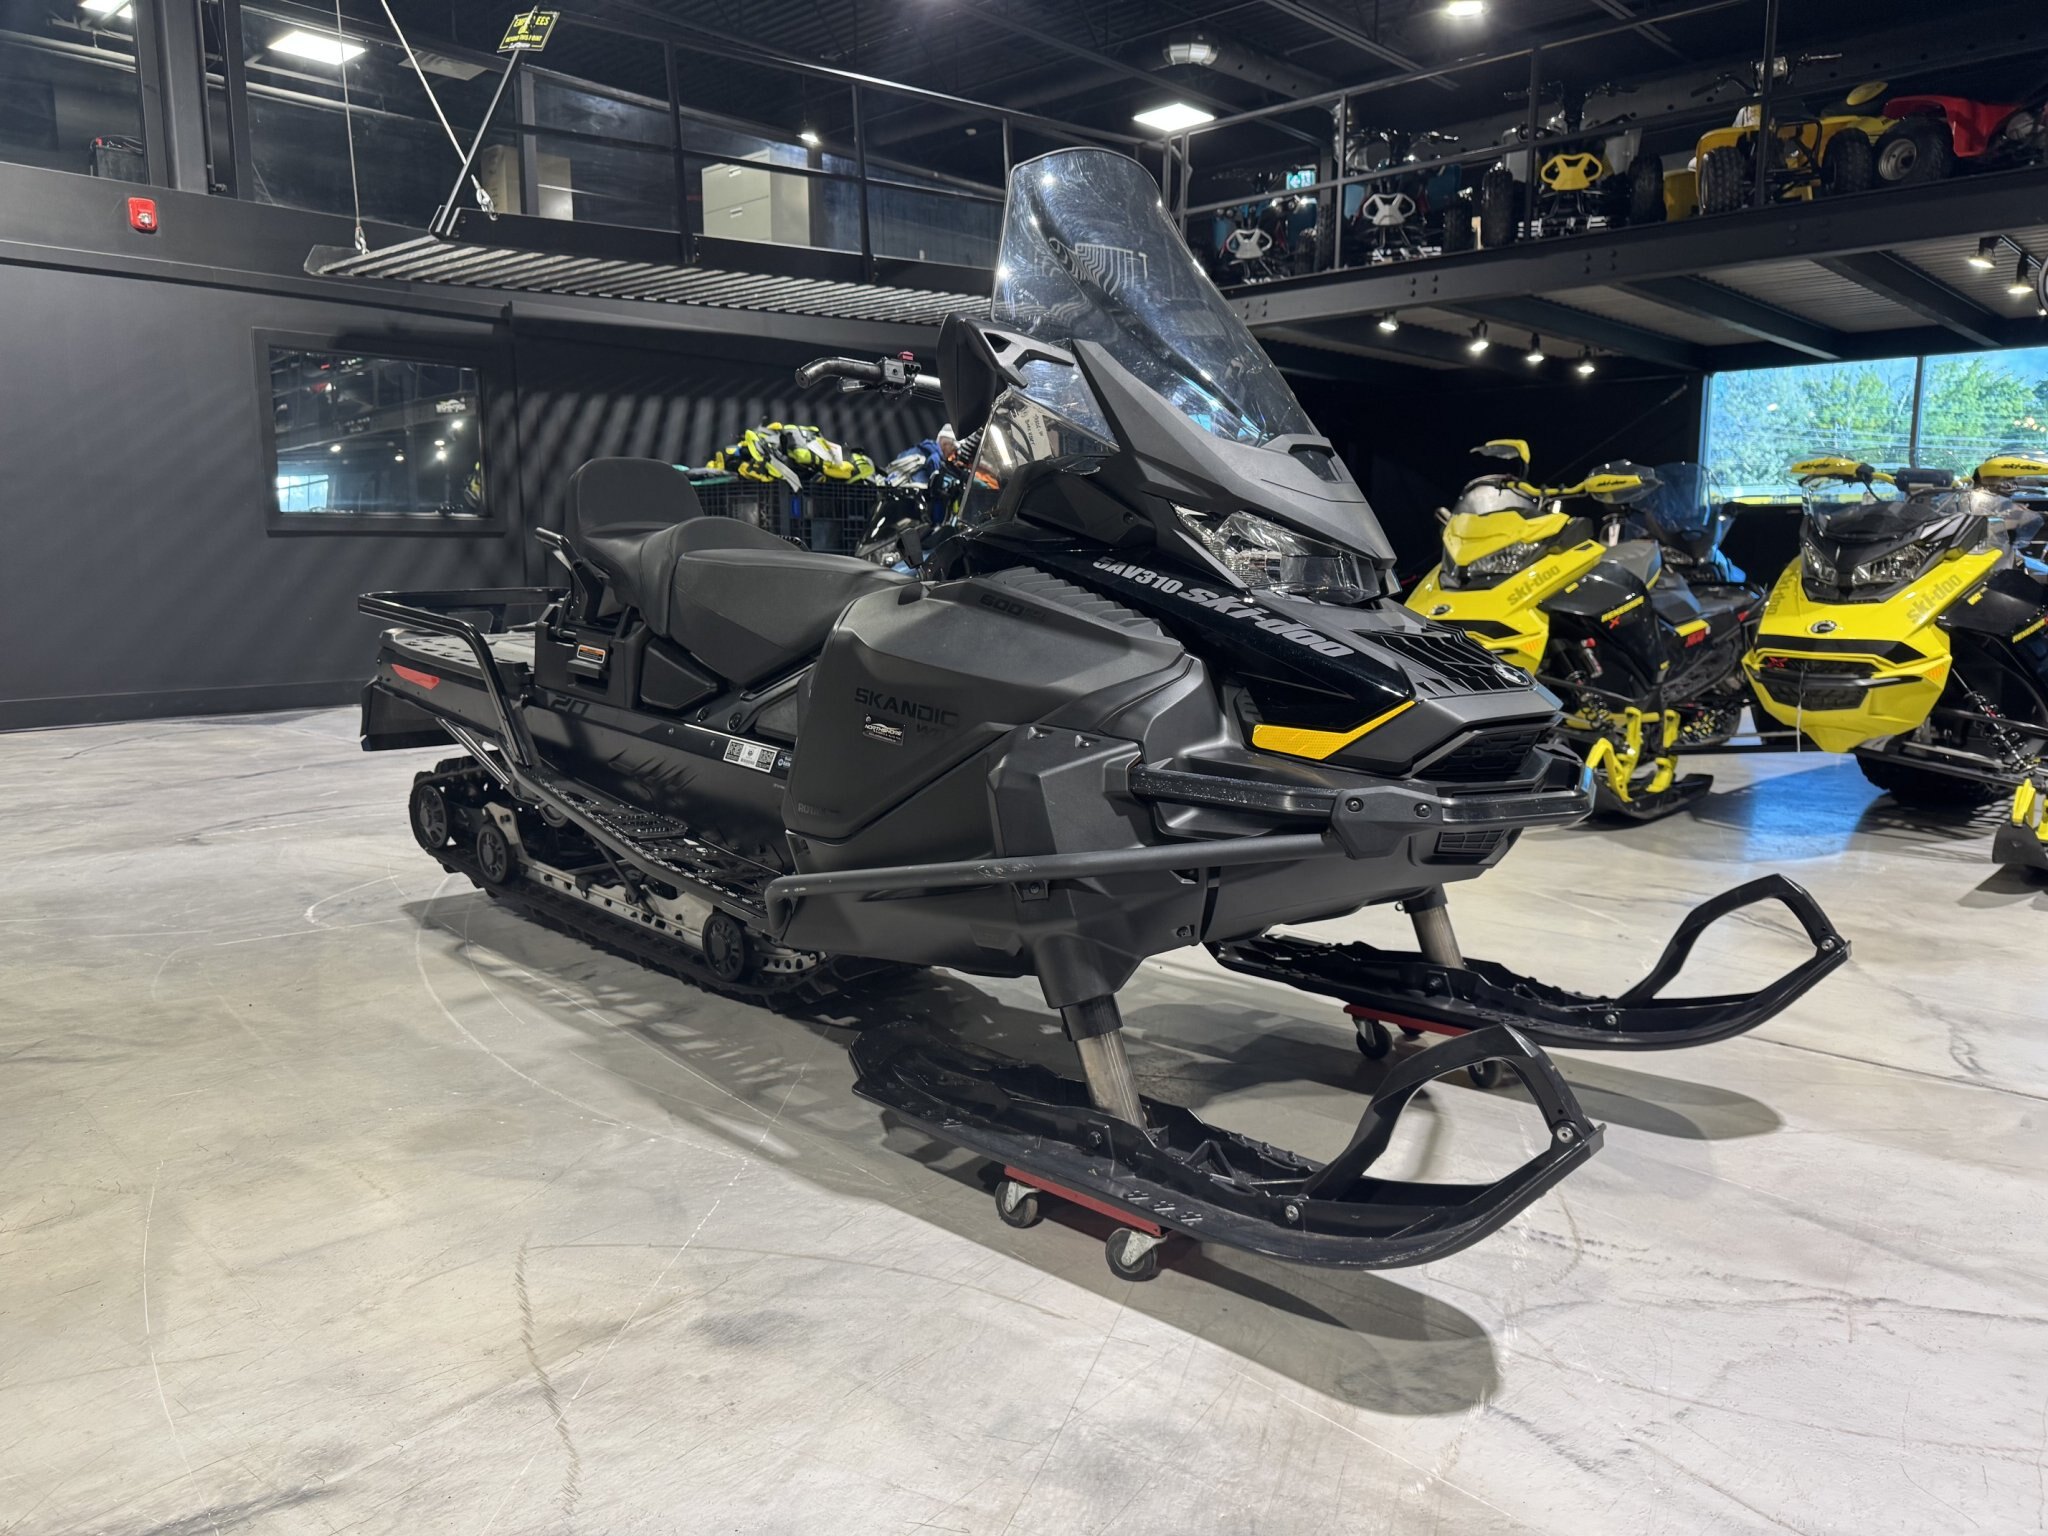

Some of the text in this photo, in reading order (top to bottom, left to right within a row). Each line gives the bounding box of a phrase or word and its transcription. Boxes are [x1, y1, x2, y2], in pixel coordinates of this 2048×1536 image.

[513, 15, 551, 28] EMEES
[1092, 556, 1184, 594] 5AV310
[1506, 564, 1561, 607] ski-doo
[1906, 572, 1963, 624] ski-doo
[854, 687, 960, 728] SKANDIC
